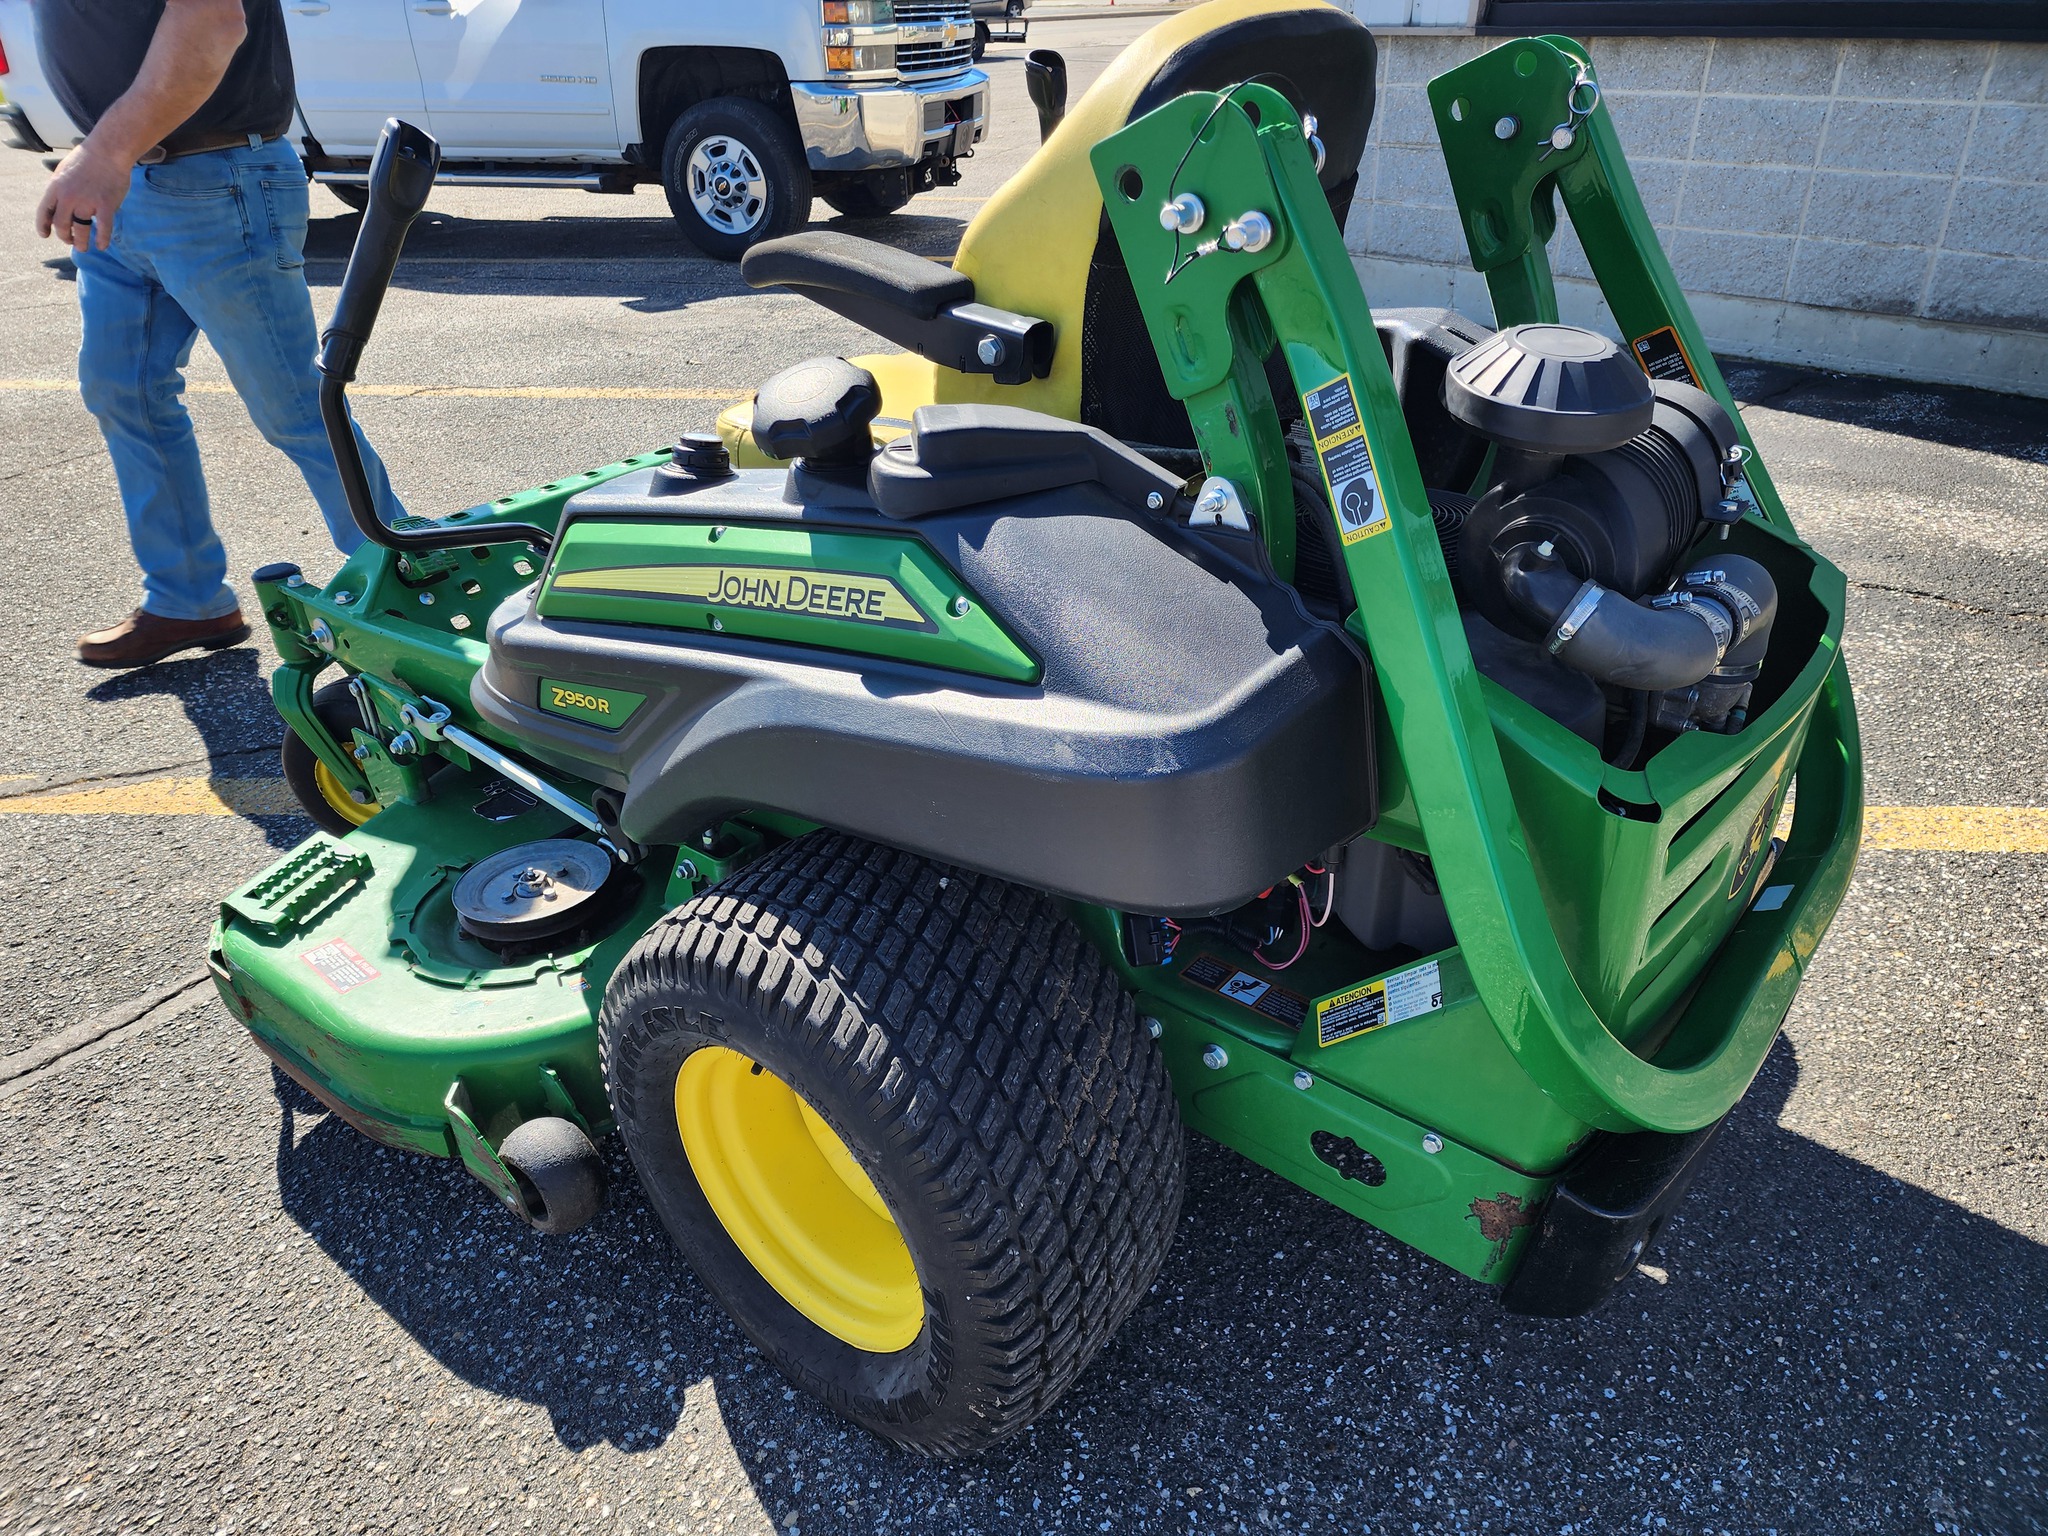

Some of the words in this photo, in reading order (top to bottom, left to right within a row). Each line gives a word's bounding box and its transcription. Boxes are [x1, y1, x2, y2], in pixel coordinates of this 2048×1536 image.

[1346, 524, 1380, 542] CAUTION
[708, 570, 780, 605] JOHN
[787, 576, 886, 617] DEERE
[551, 687, 610, 714] Z950R
[615, 1005, 728, 1121] CARLISLE
[921, 1286, 954, 1407] TURF
